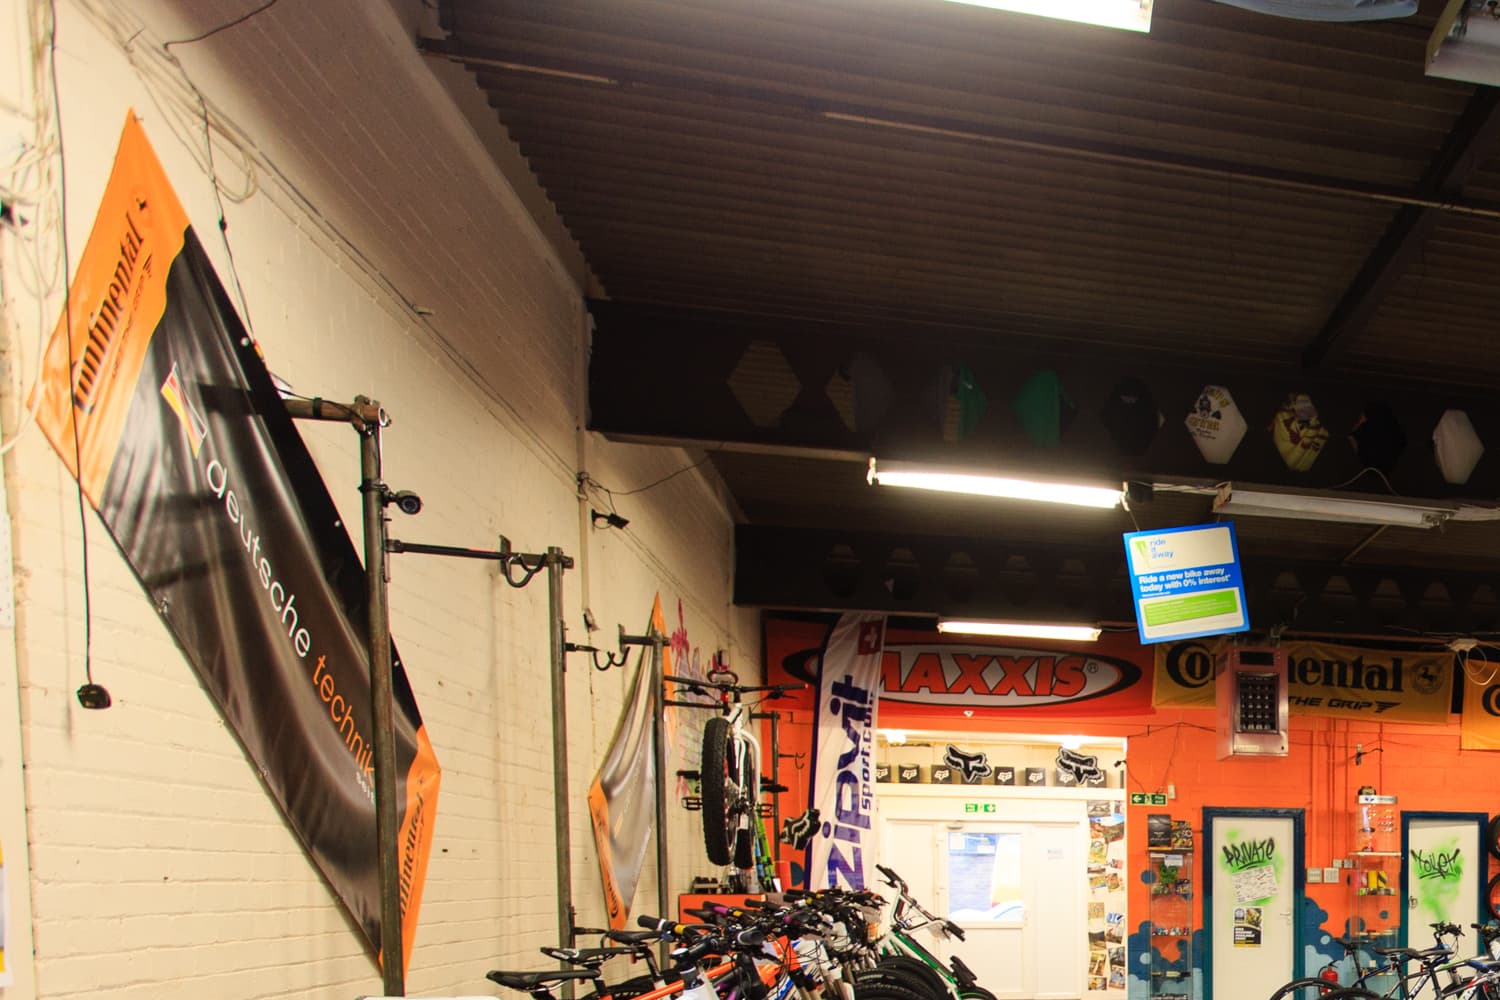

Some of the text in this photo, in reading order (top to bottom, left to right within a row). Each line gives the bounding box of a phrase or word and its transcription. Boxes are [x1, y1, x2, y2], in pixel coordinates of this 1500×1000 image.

[1138, 574, 1159, 585] Ride
[1165, 573, 1184, 581] new
[1184, 569, 1203, 579] bike
[1203, 567, 1225, 577] away
[1139, 582, 1164, 593] today
[1164, 580, 1183, 590] with
[1182, 578, 1198, 588] 0%
[206, 458, 376, 790] deutsche technik
[1166, 640, 1405, 693] Coental
[1328, 698, 1373, 711] GRIP
